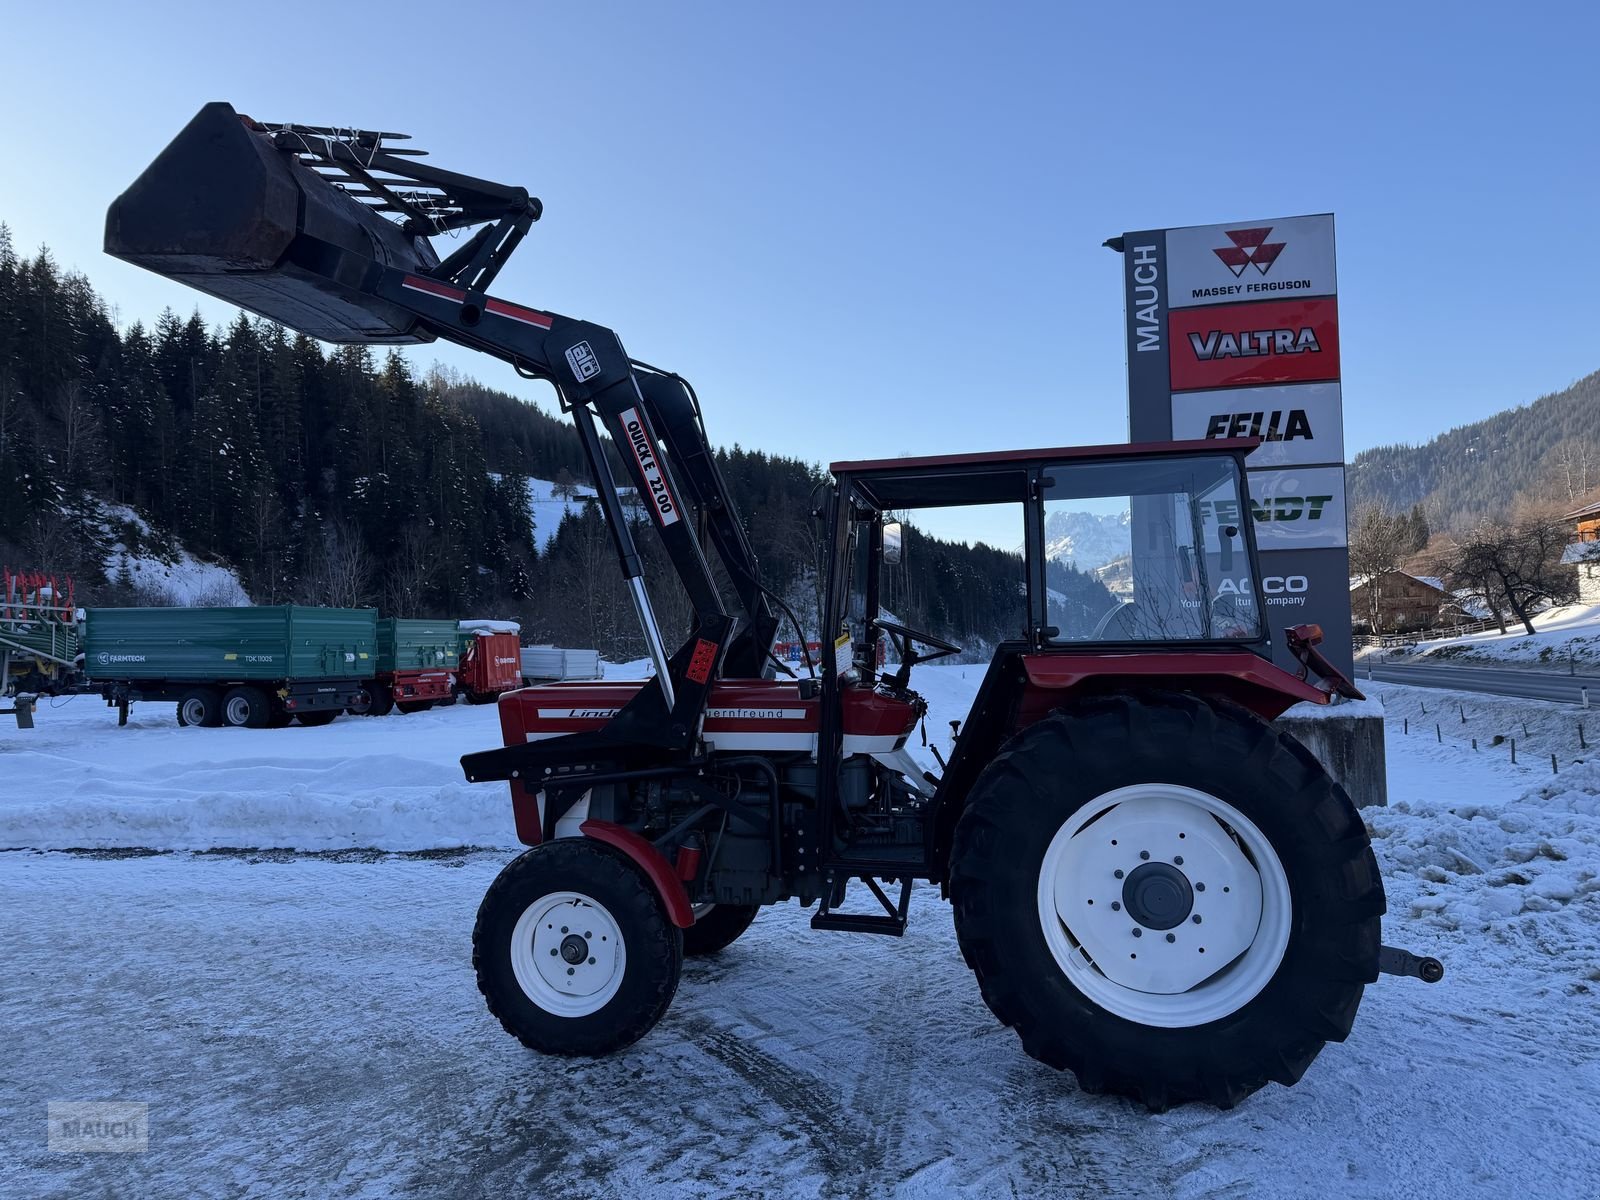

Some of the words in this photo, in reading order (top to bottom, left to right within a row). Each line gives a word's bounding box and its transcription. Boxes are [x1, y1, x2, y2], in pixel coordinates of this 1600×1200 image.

[1133, 244, 1161, 352] MAUCH
[1192, 285, 1242, 298] MASSEY
[1246, 280, 1311, 293] FERGUSON
[1187, 327, 1322, 361] VALTRA
[1205, 409, 1314, 442] FELLA
[1264, 596, 1306, 607] ompany
[705, 709, 783, 718] uernfreund
